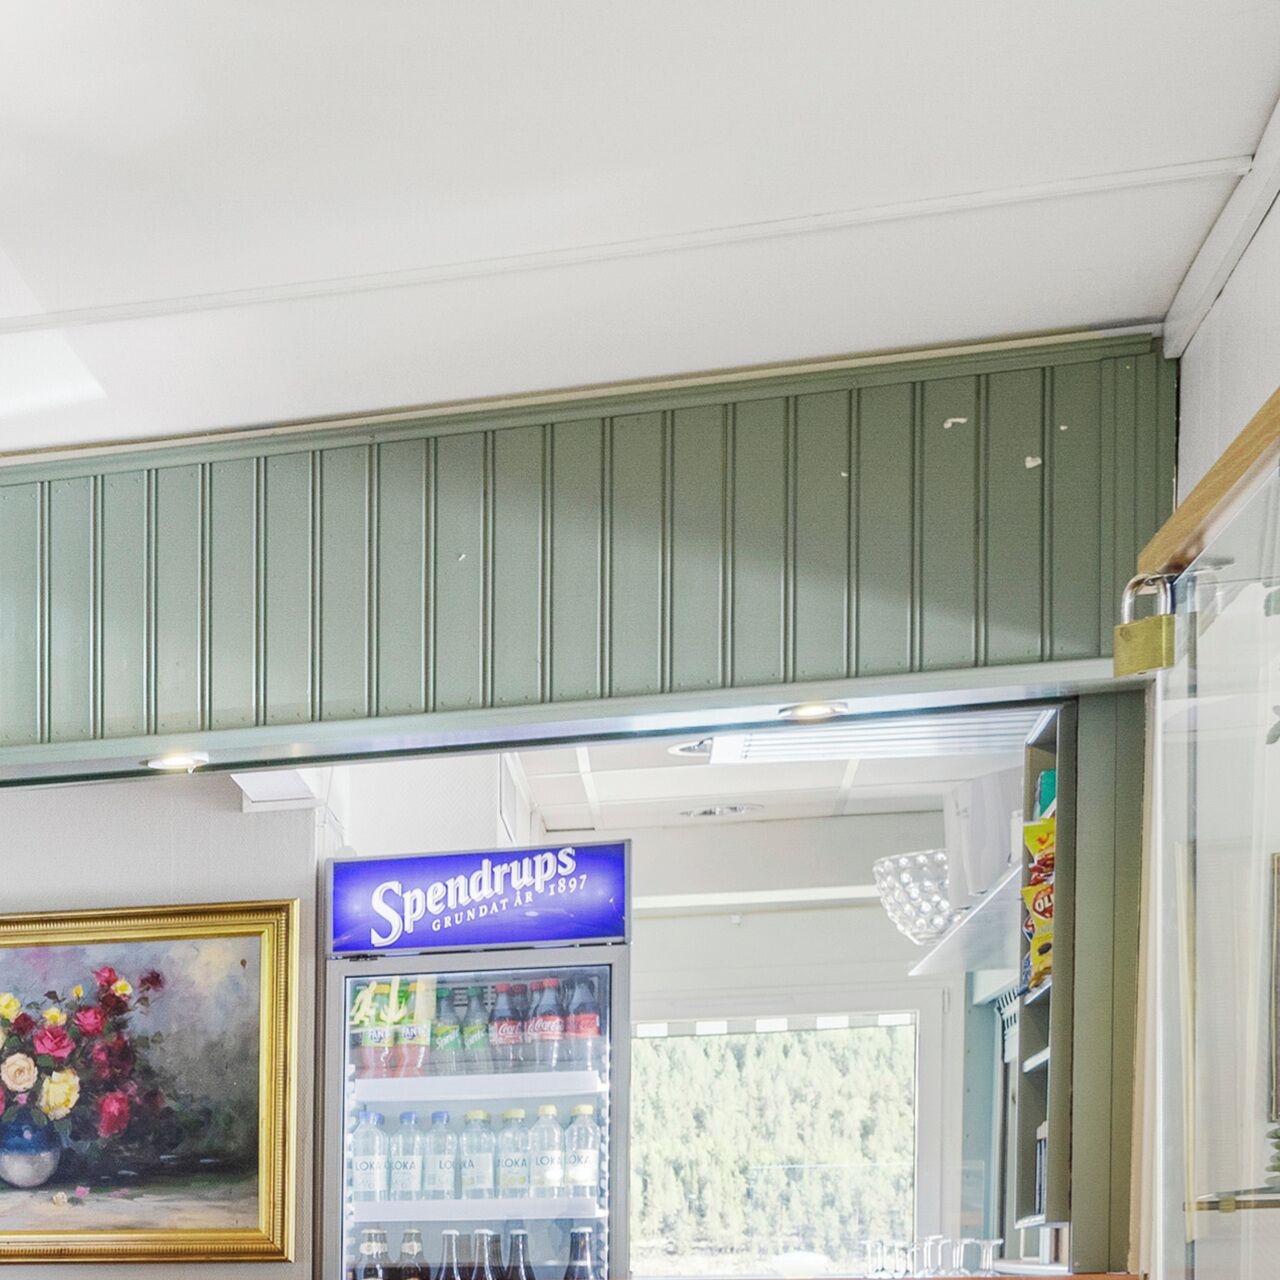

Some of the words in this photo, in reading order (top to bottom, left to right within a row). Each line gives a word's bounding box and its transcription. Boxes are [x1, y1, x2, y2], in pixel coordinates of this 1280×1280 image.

[371, 847, 576, 947] Spendrups
[432, 899, 508, 932] GRUNDAT
[513, 890, 533, 908] ÅR
[549, 874, 588, 897] 1897
[1036, 896, 1054, 912] OL
[355, 1161, 379, 1171] LOK
